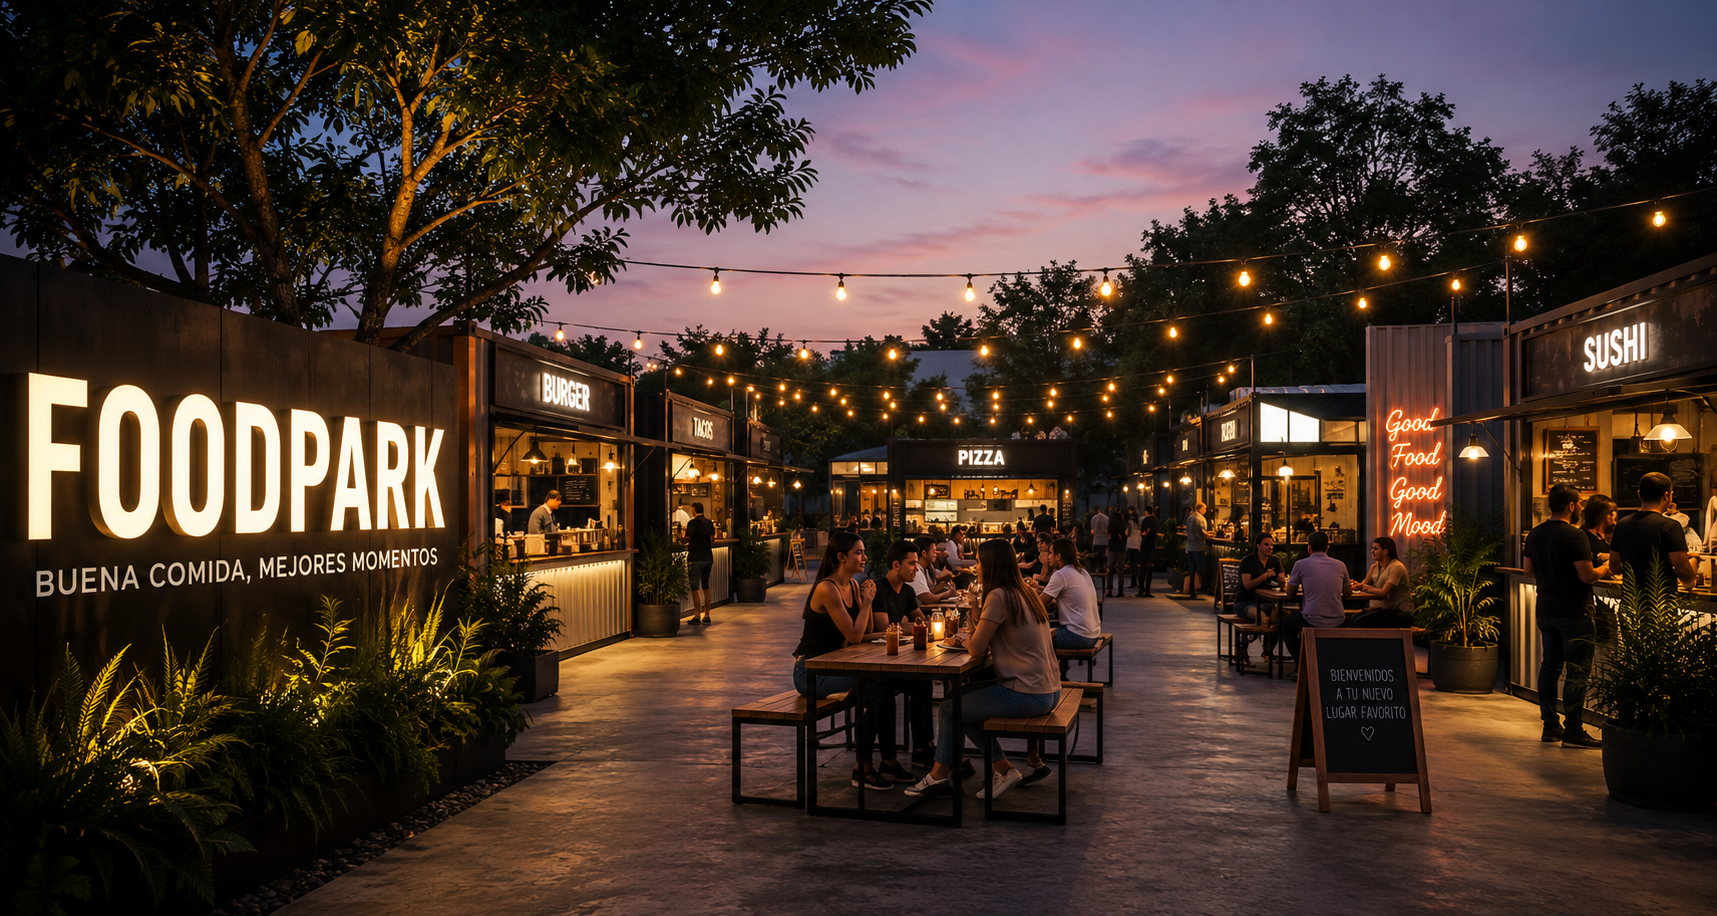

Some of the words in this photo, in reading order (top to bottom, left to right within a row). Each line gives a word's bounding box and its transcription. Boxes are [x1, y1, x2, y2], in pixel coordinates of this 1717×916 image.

[1583, 321, 1648, 373] SUSHI
[541, 372, 590, 412] BURGER
[693, 417, 714, 441] TACOS
[1385, 407, 1440, 441] Good
[27, 372, 447, 541] FOODPARK
[957, 449, 1005, 466] PIZZA
[1391, 442, 1442, 467] Food
[1390, 476, 1443, 509] Good
[1390, 510, 1447, 536] Mood
[36, 564, 140, 598] BUENA
[148, 558, 251, 588] COMIDA,
[259, 552, 346, 580] MEJORES
[352, 547, 439, 572] MOMENTOS
[1330, 668, 1394, 682] BIENVENIDOS
[1336, 687, 1343, 701] A
[1345, 687, 1358, 701] TU
[1362, 687, 1393, 701] NUEVO
[1326, 706, 1357, 719] LUGAR
[1361, 706, 1406, 720] FAVORITO
